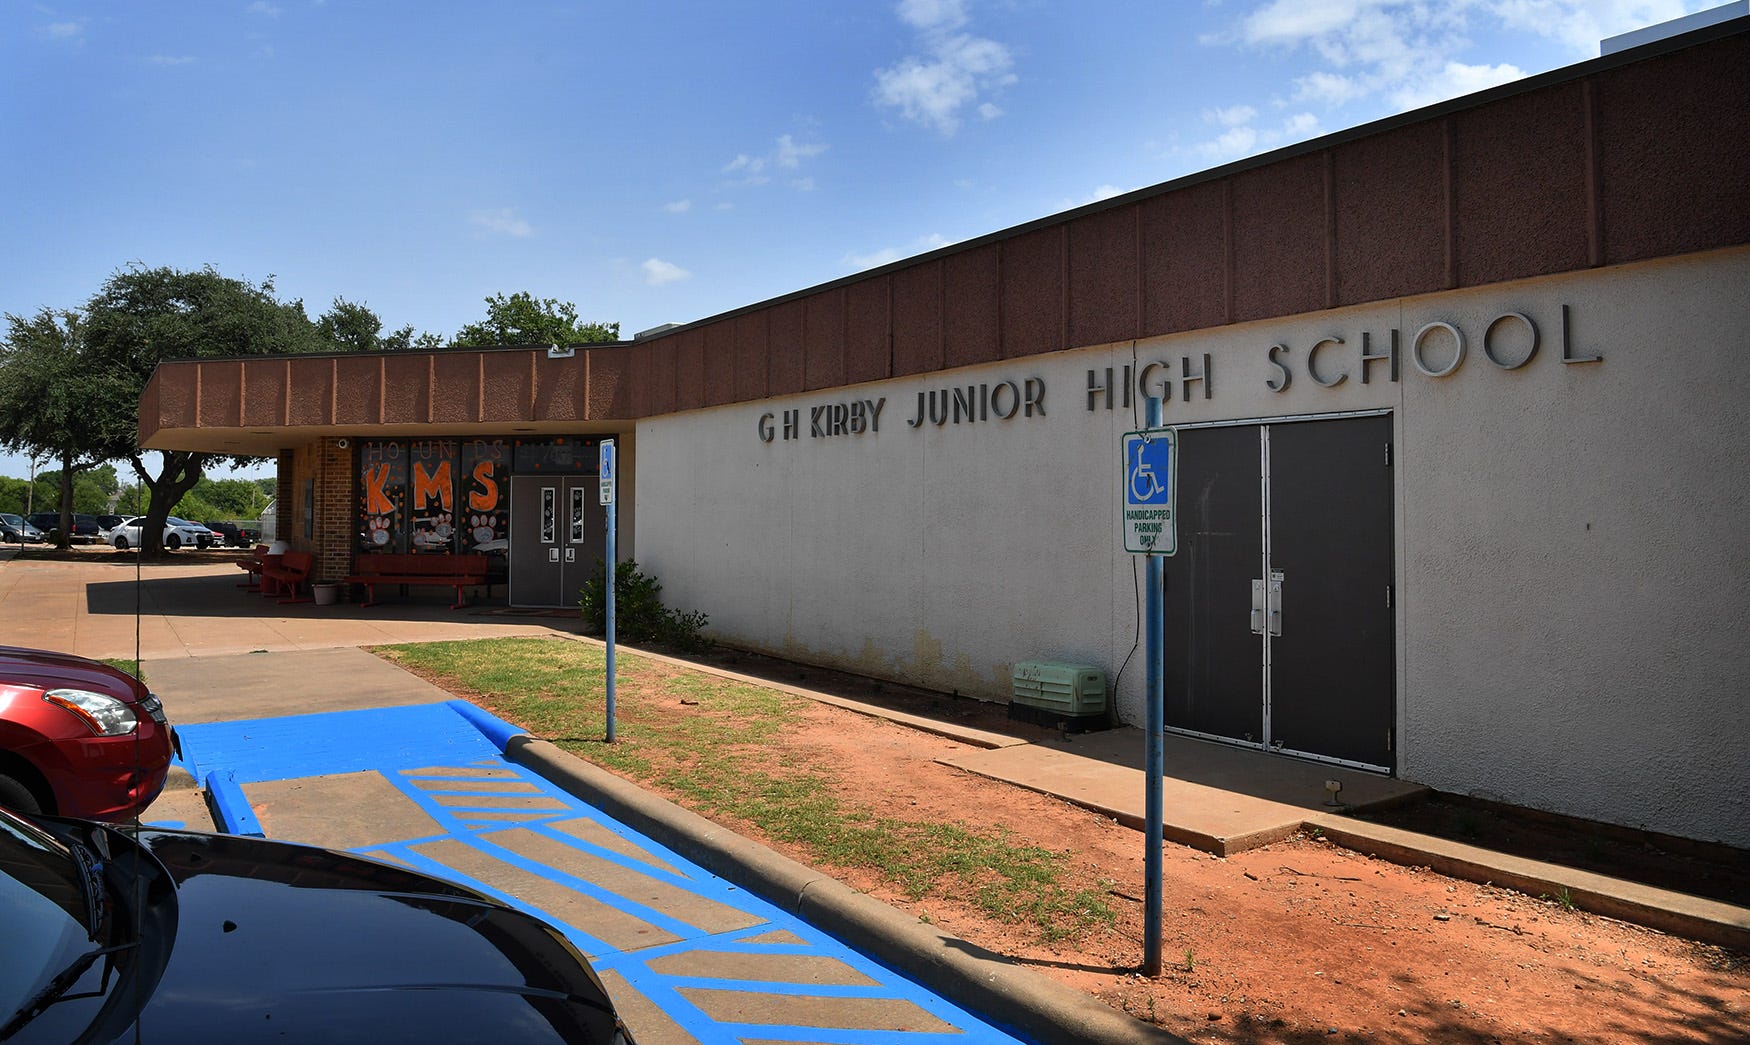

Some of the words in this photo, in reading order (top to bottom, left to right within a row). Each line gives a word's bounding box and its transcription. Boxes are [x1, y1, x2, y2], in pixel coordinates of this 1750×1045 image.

[758, 412, 775, 443] G
[783, 409, 799, 440] H
[810, 397, 886, 438] KIRBY
[907, 376, 1046, 428] JUNIOR
[1087, 353, 1211, 412] HIGH
[1266, 304, 1603, 394] SCHOOL
[366, 460, 499, 515] KMS
[1126, 510, 1170, 520] HANDICAPPED
[1134, 522, 1162, 533] PARKING
